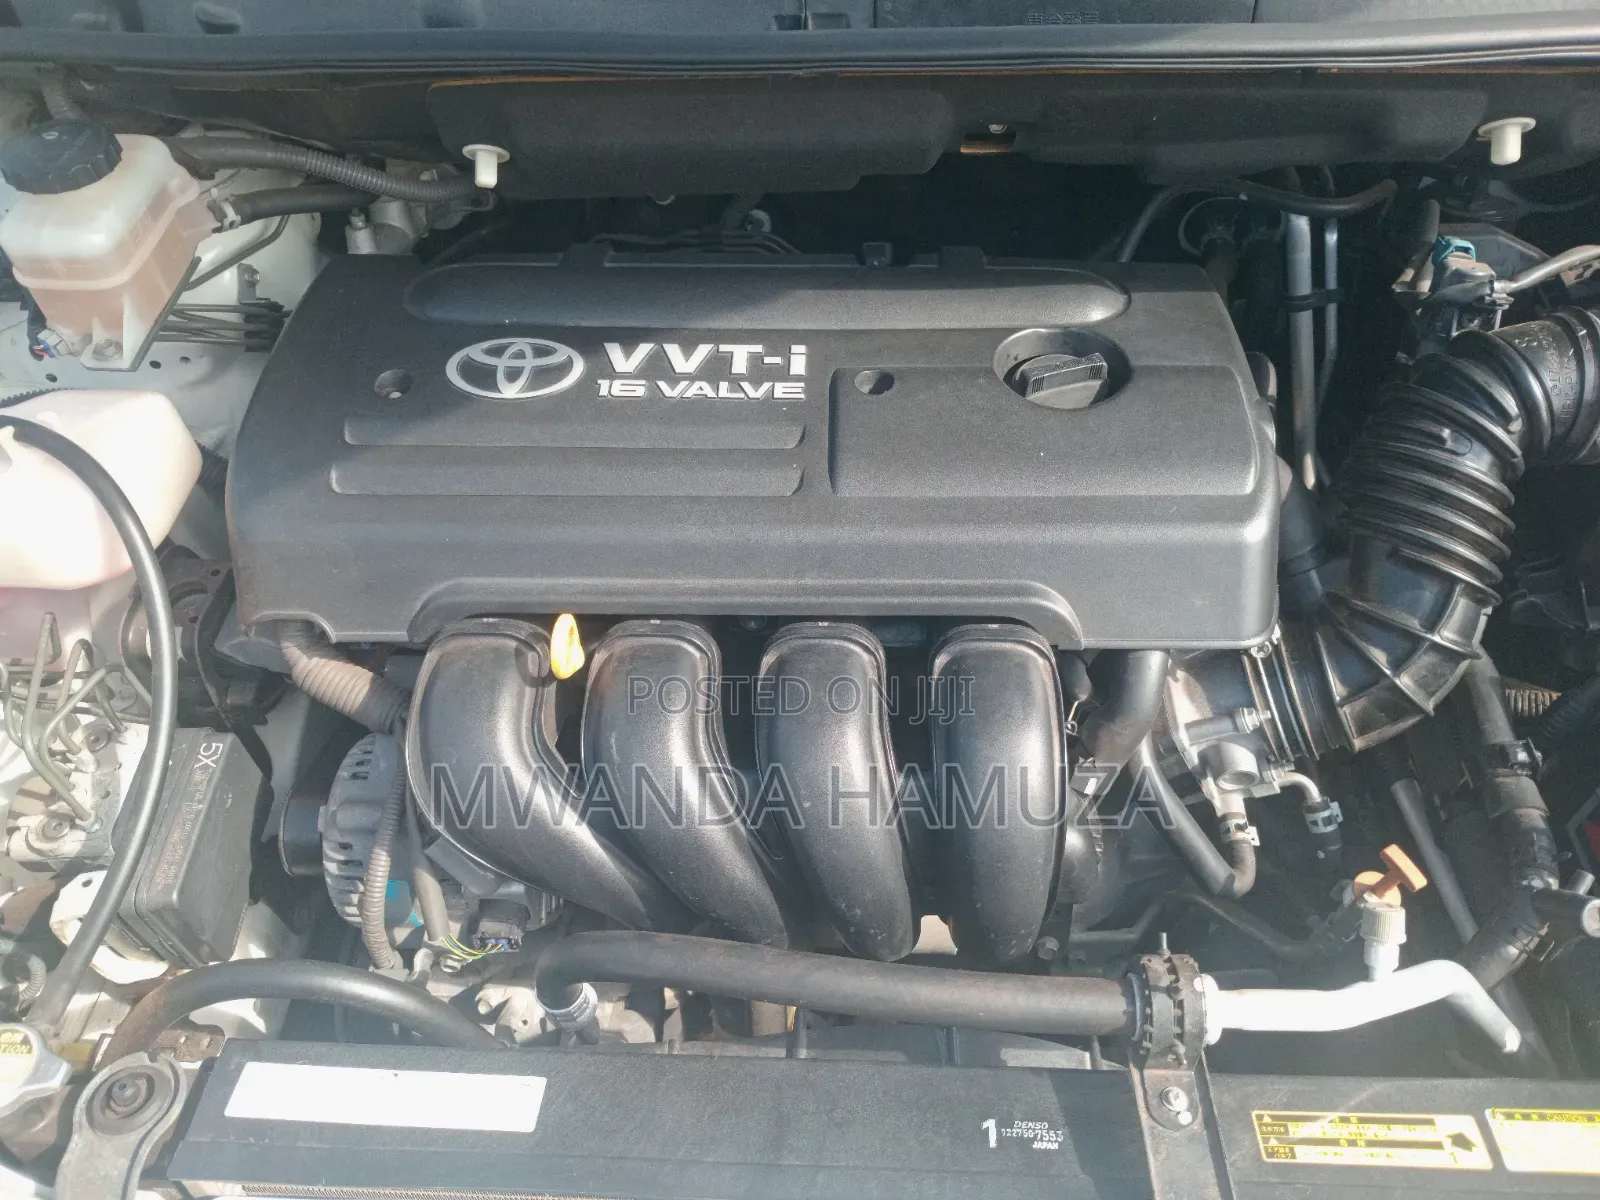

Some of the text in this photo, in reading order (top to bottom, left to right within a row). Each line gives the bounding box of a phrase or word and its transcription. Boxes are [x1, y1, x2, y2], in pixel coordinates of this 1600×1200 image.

[603, 342, 807, 376] VVT-i
[597, 379, 805, 400] 16 VALVE
[194, 742, 224, 768] 5X
[981, 1118, 998, 1148] 1
[1013, 1120, 1049, 1130] DENSO
[1032, 1141, 1059, 1150] JAPAN
